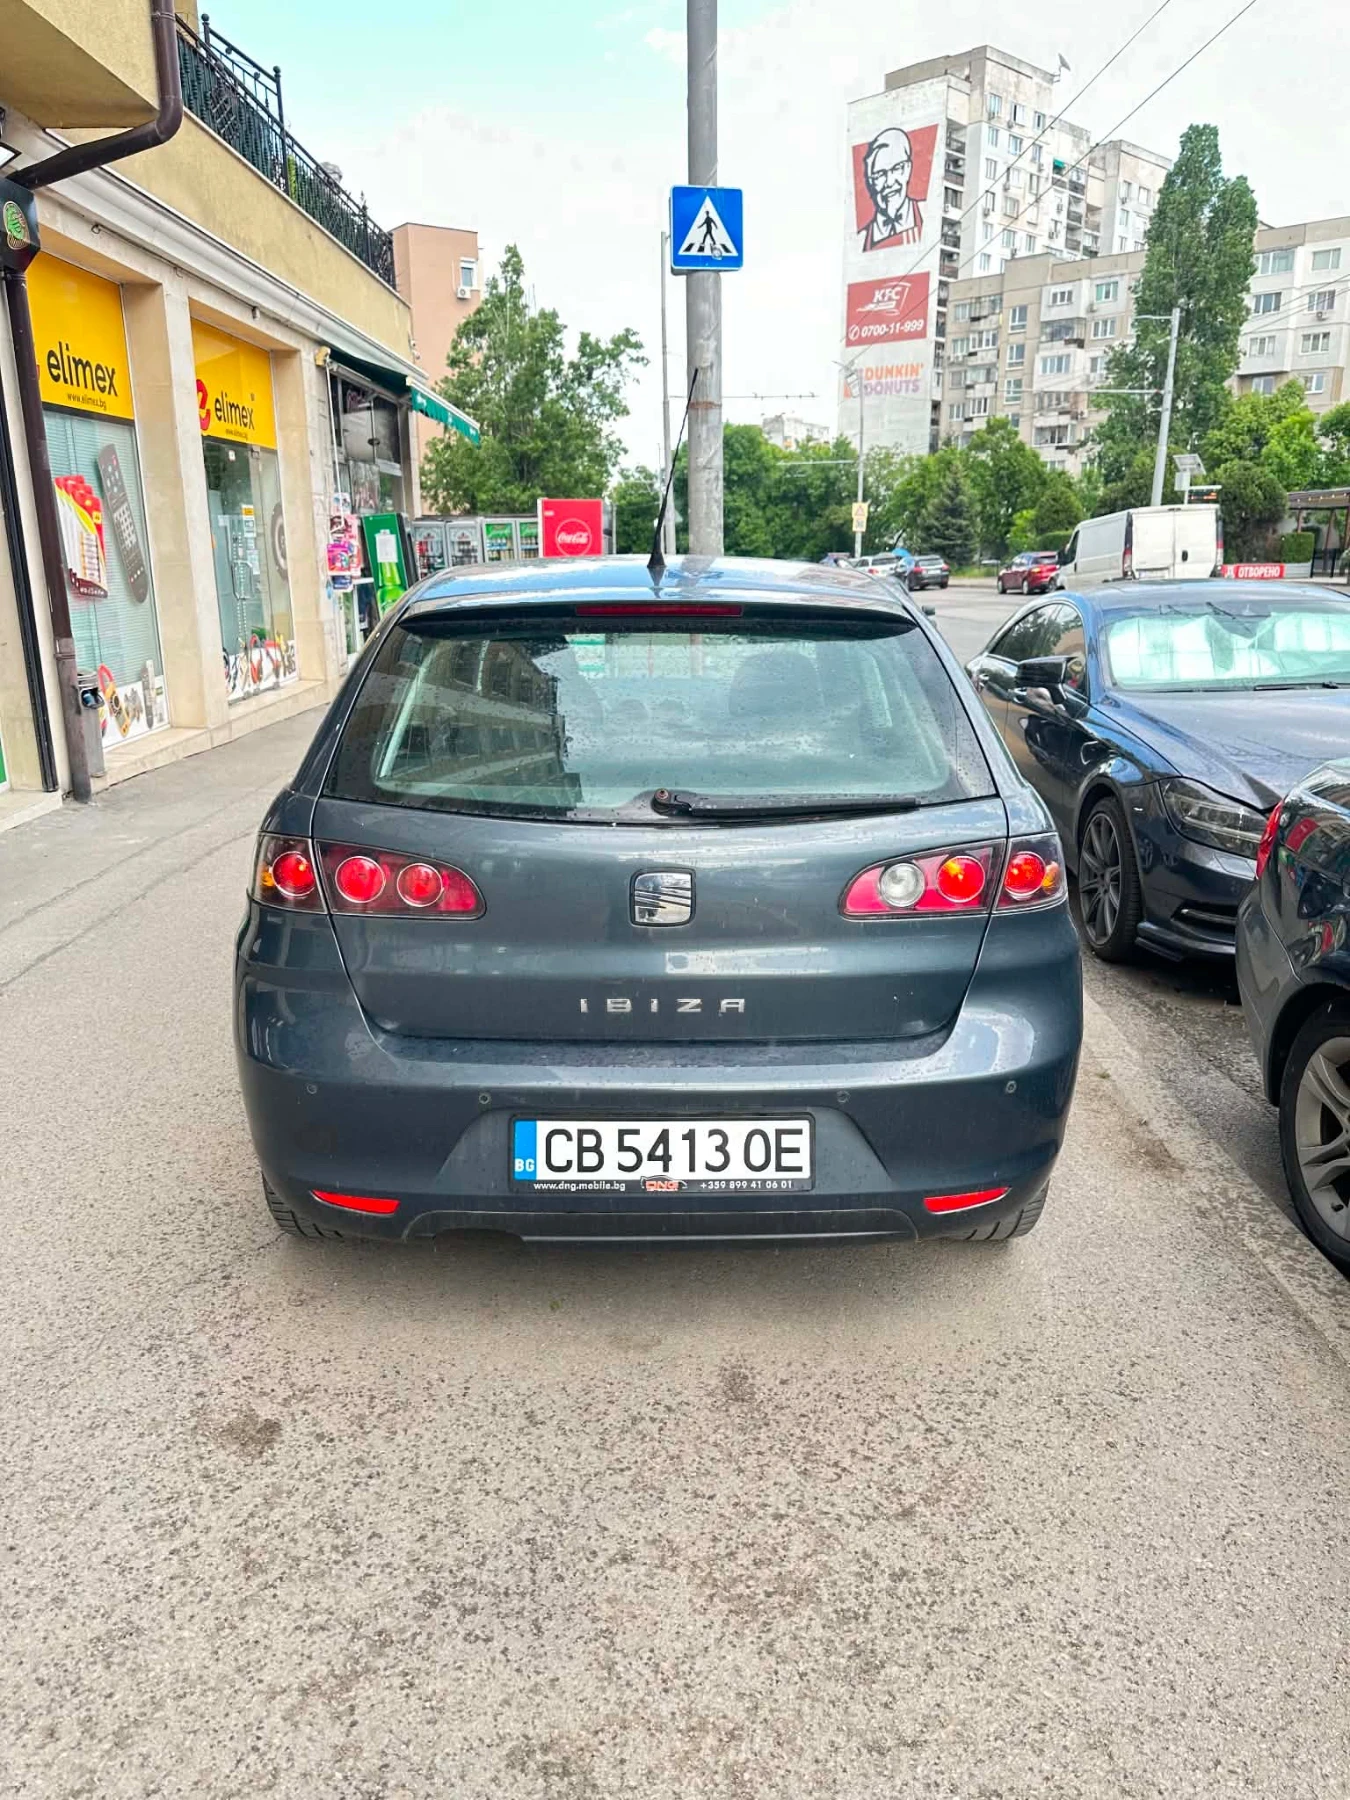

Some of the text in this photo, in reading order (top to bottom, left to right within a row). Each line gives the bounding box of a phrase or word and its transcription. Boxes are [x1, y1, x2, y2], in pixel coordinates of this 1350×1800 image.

[873, 287, 902, 302] KFC
[861, 319, 925, 338] 0700-11-999
[46, 340, 118, 397] elimex
[863, 380, 921, 396] DONUTS
[214, 390, 255, 430] elimex
[1238, 565, 1281, 578] ОТВОРЕНО
[580, 998, 745, 1013] IBIZA
[545, 1128, 605, 1173] CB
[617, 1128, 731, 1173] 5413
[514, 1158, 535, 1172] BG
[533, 1181, 626, 1191] www.dng.mobile.bg
[700, 1180, 793, 1189] +359 899 41 06 01
